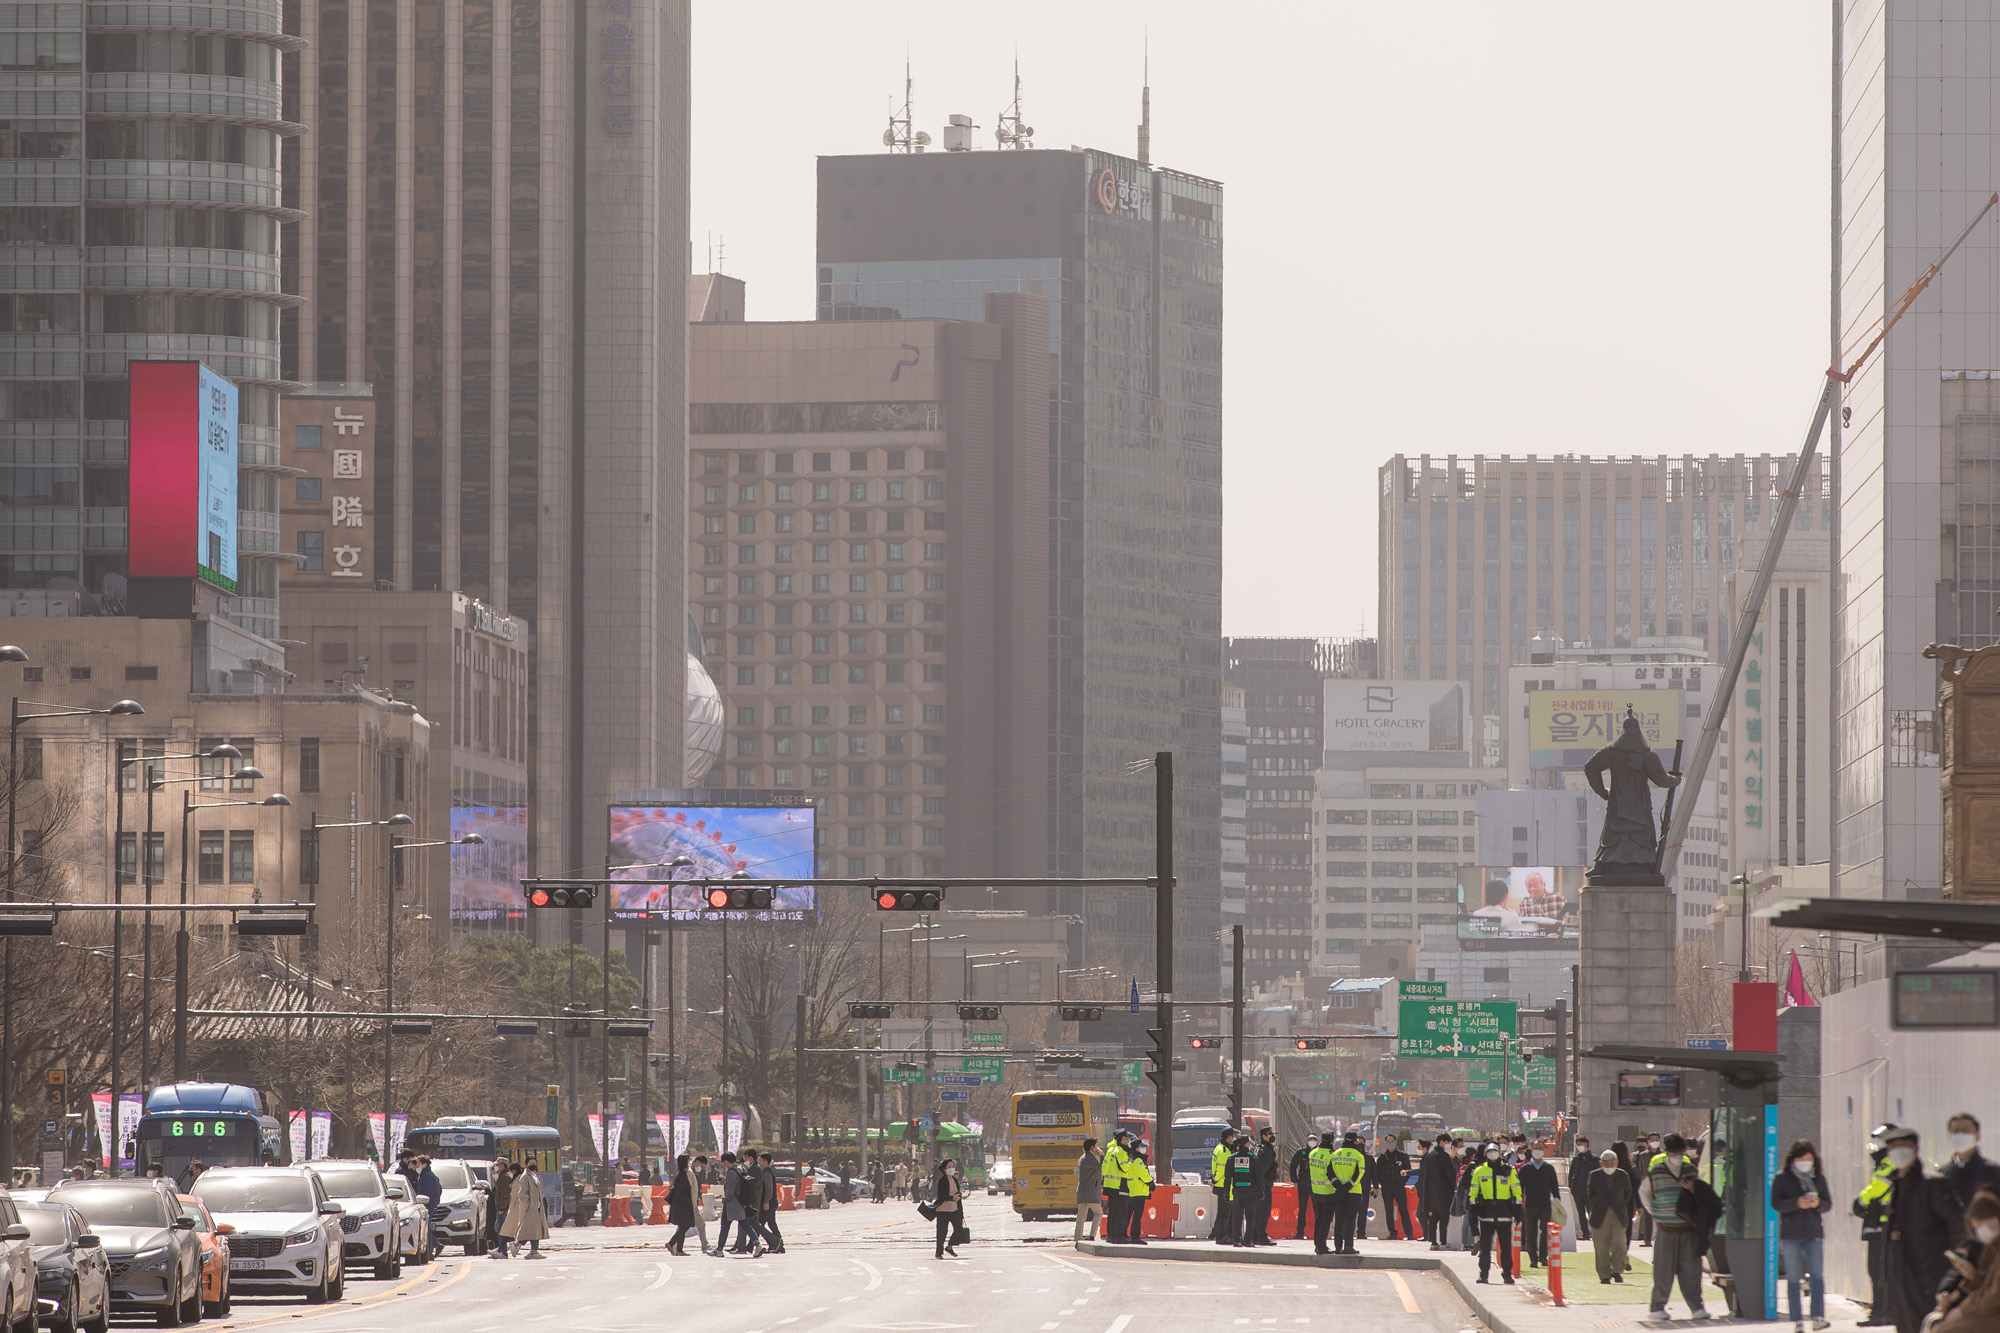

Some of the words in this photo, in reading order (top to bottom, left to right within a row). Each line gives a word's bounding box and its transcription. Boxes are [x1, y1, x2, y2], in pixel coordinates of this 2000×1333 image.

[1118, 180, 1141, 220] 한화
[1635, 667, 1701, 680] 삼정빌딩
[1552, 701, 1568, 711] 전국
[1569, 701, 1595, 711] 취업률
[1597, 701, 1613, 711] 1위!
[1335, 718, 1371, 728] HOTEL
[1373, 718, 1426, 728] GRACERY
[1548, 712, 1613, 742] 을지
[1745, 631, 1762, 829] 서울특별시의회
[1475, 941, 1486, 949] LG
[1405, 984, 1443, 994] 세종대로사거리
[1428, 1005, 1454, 1015] 숭례문
[1469, 1017, 1499, 1027] 시의회
[52, 1090, 61, 1103] 3
[1056, 1113, 1080, 1124] 5500-2
[172, 1121, 226, 1137] 606
